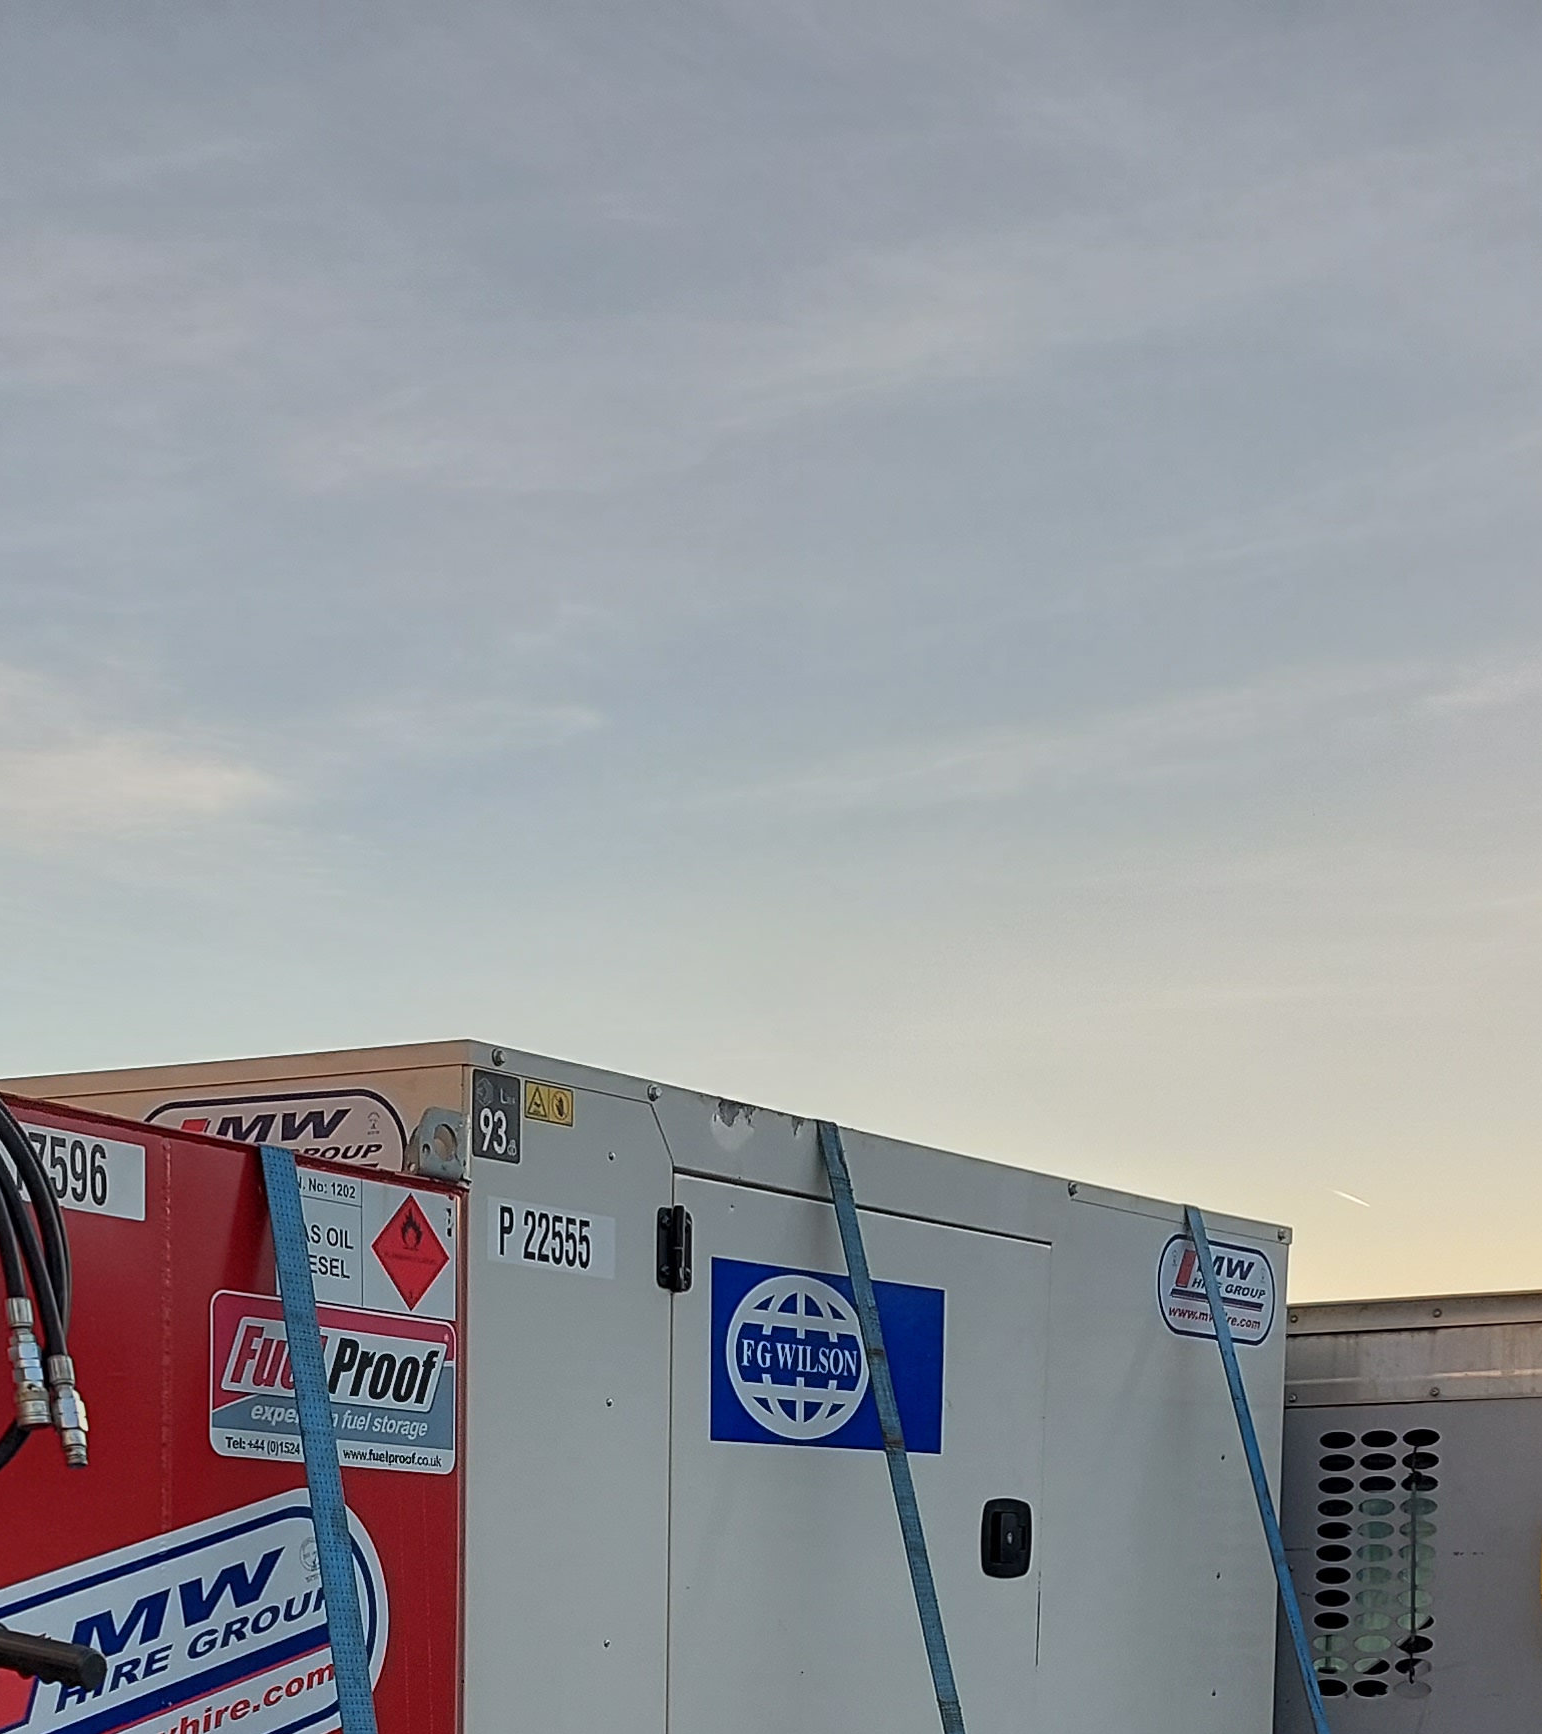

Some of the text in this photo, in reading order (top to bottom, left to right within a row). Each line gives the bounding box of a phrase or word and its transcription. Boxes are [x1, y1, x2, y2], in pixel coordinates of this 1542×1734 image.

[216, 1107, 352, 1143] MW
[479, 1107, 507, 1154] 93
[308, 1177, 327, 1194] No:
[331, 1182, 356, 1199] 1202
[326, 1227, 354, 1250] OIL
[499, 1204, 591, 1270] P 22555
[309, 1254, 350, 1279] ESEL
[1225, 1283, 1266, 1299] GROUP
[328, 1337, 440, 1405] Proof
[775, 1342, 858, 1377] WILSON
[341, 1409, 371, 1430] fuel
[372, 1417, 428, 1440] storage
[225, 1436, 442, 1468] Tel: +44 (0)1524 www.fuelproof.co.uk
[71, 1546, 286, 1657] MW
